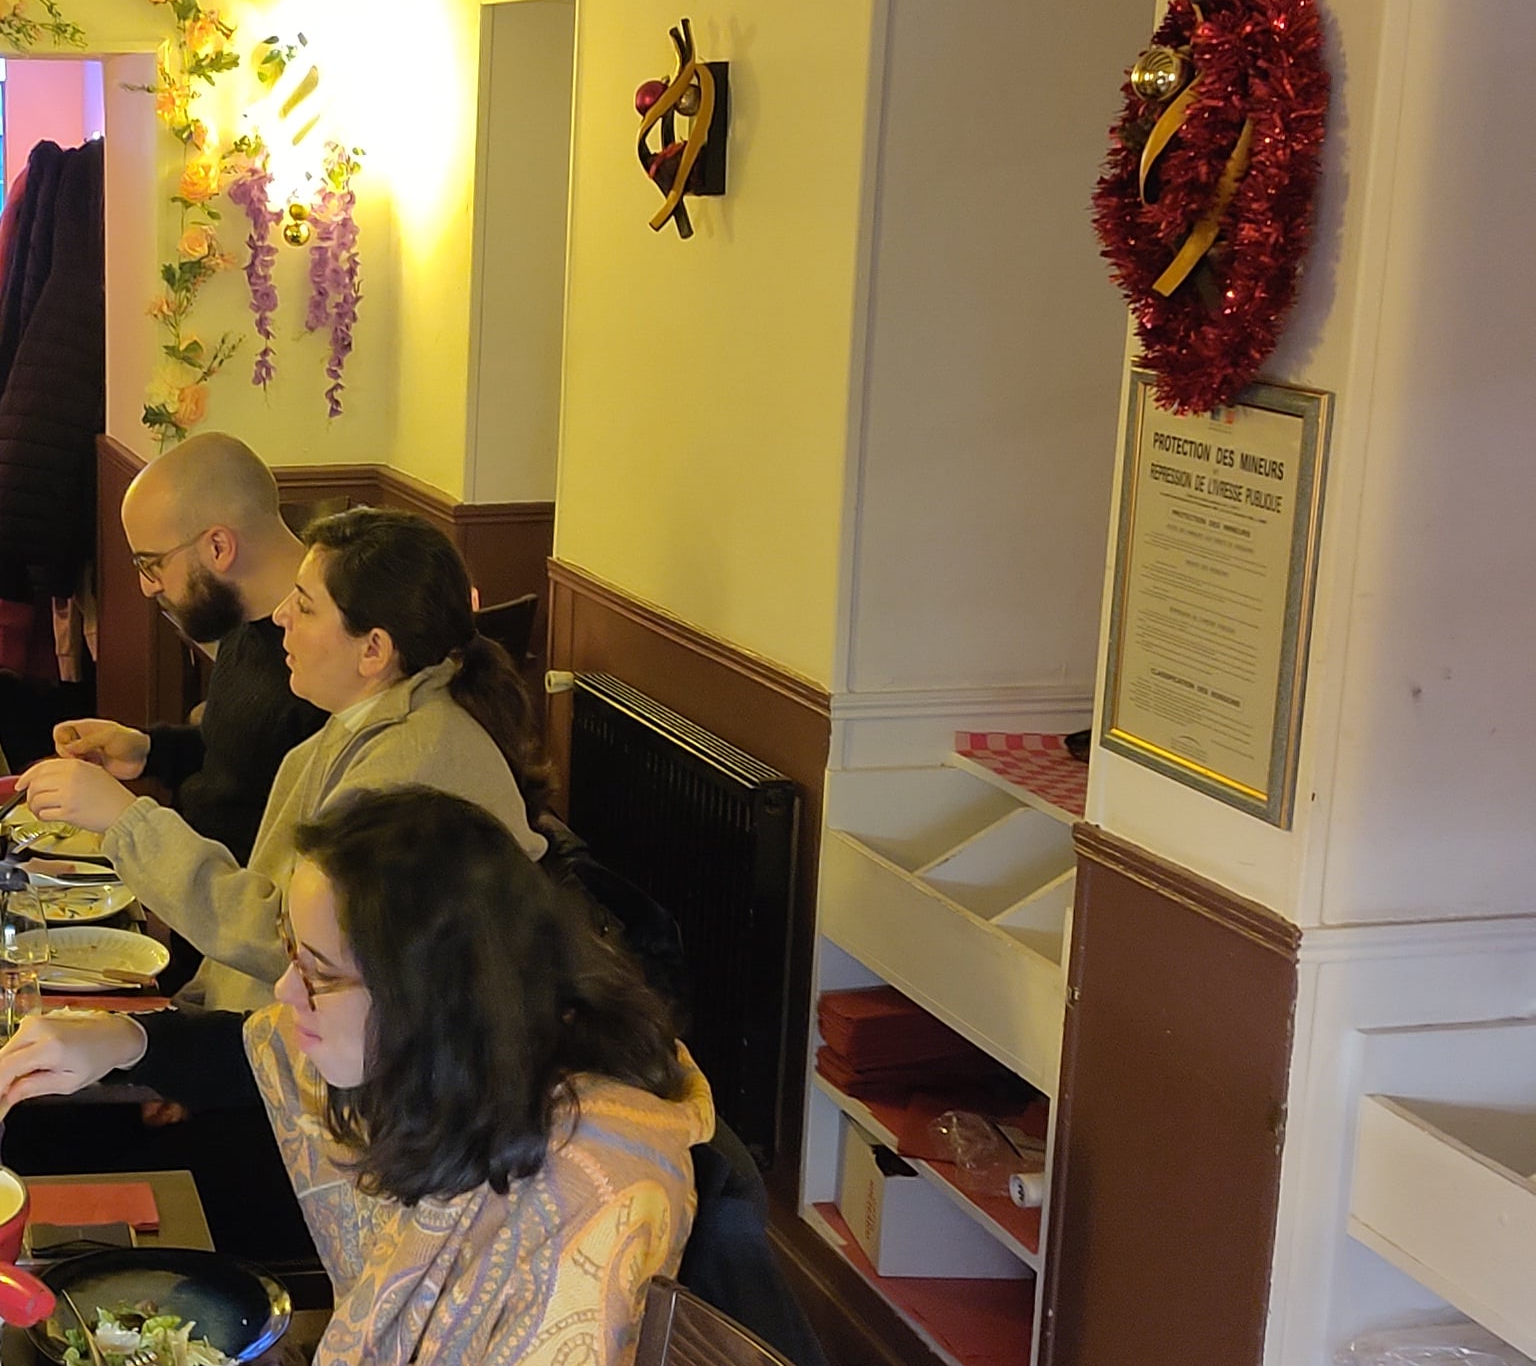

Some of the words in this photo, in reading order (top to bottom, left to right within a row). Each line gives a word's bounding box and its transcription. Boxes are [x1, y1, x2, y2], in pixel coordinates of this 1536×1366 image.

[1153, 432, 1211, 462] PROTECTION
[1216, 447, 1235, 467] DES
[1239, 452, 1284, 481] MINEURS
[1195, 474, 1206, 493] DE
